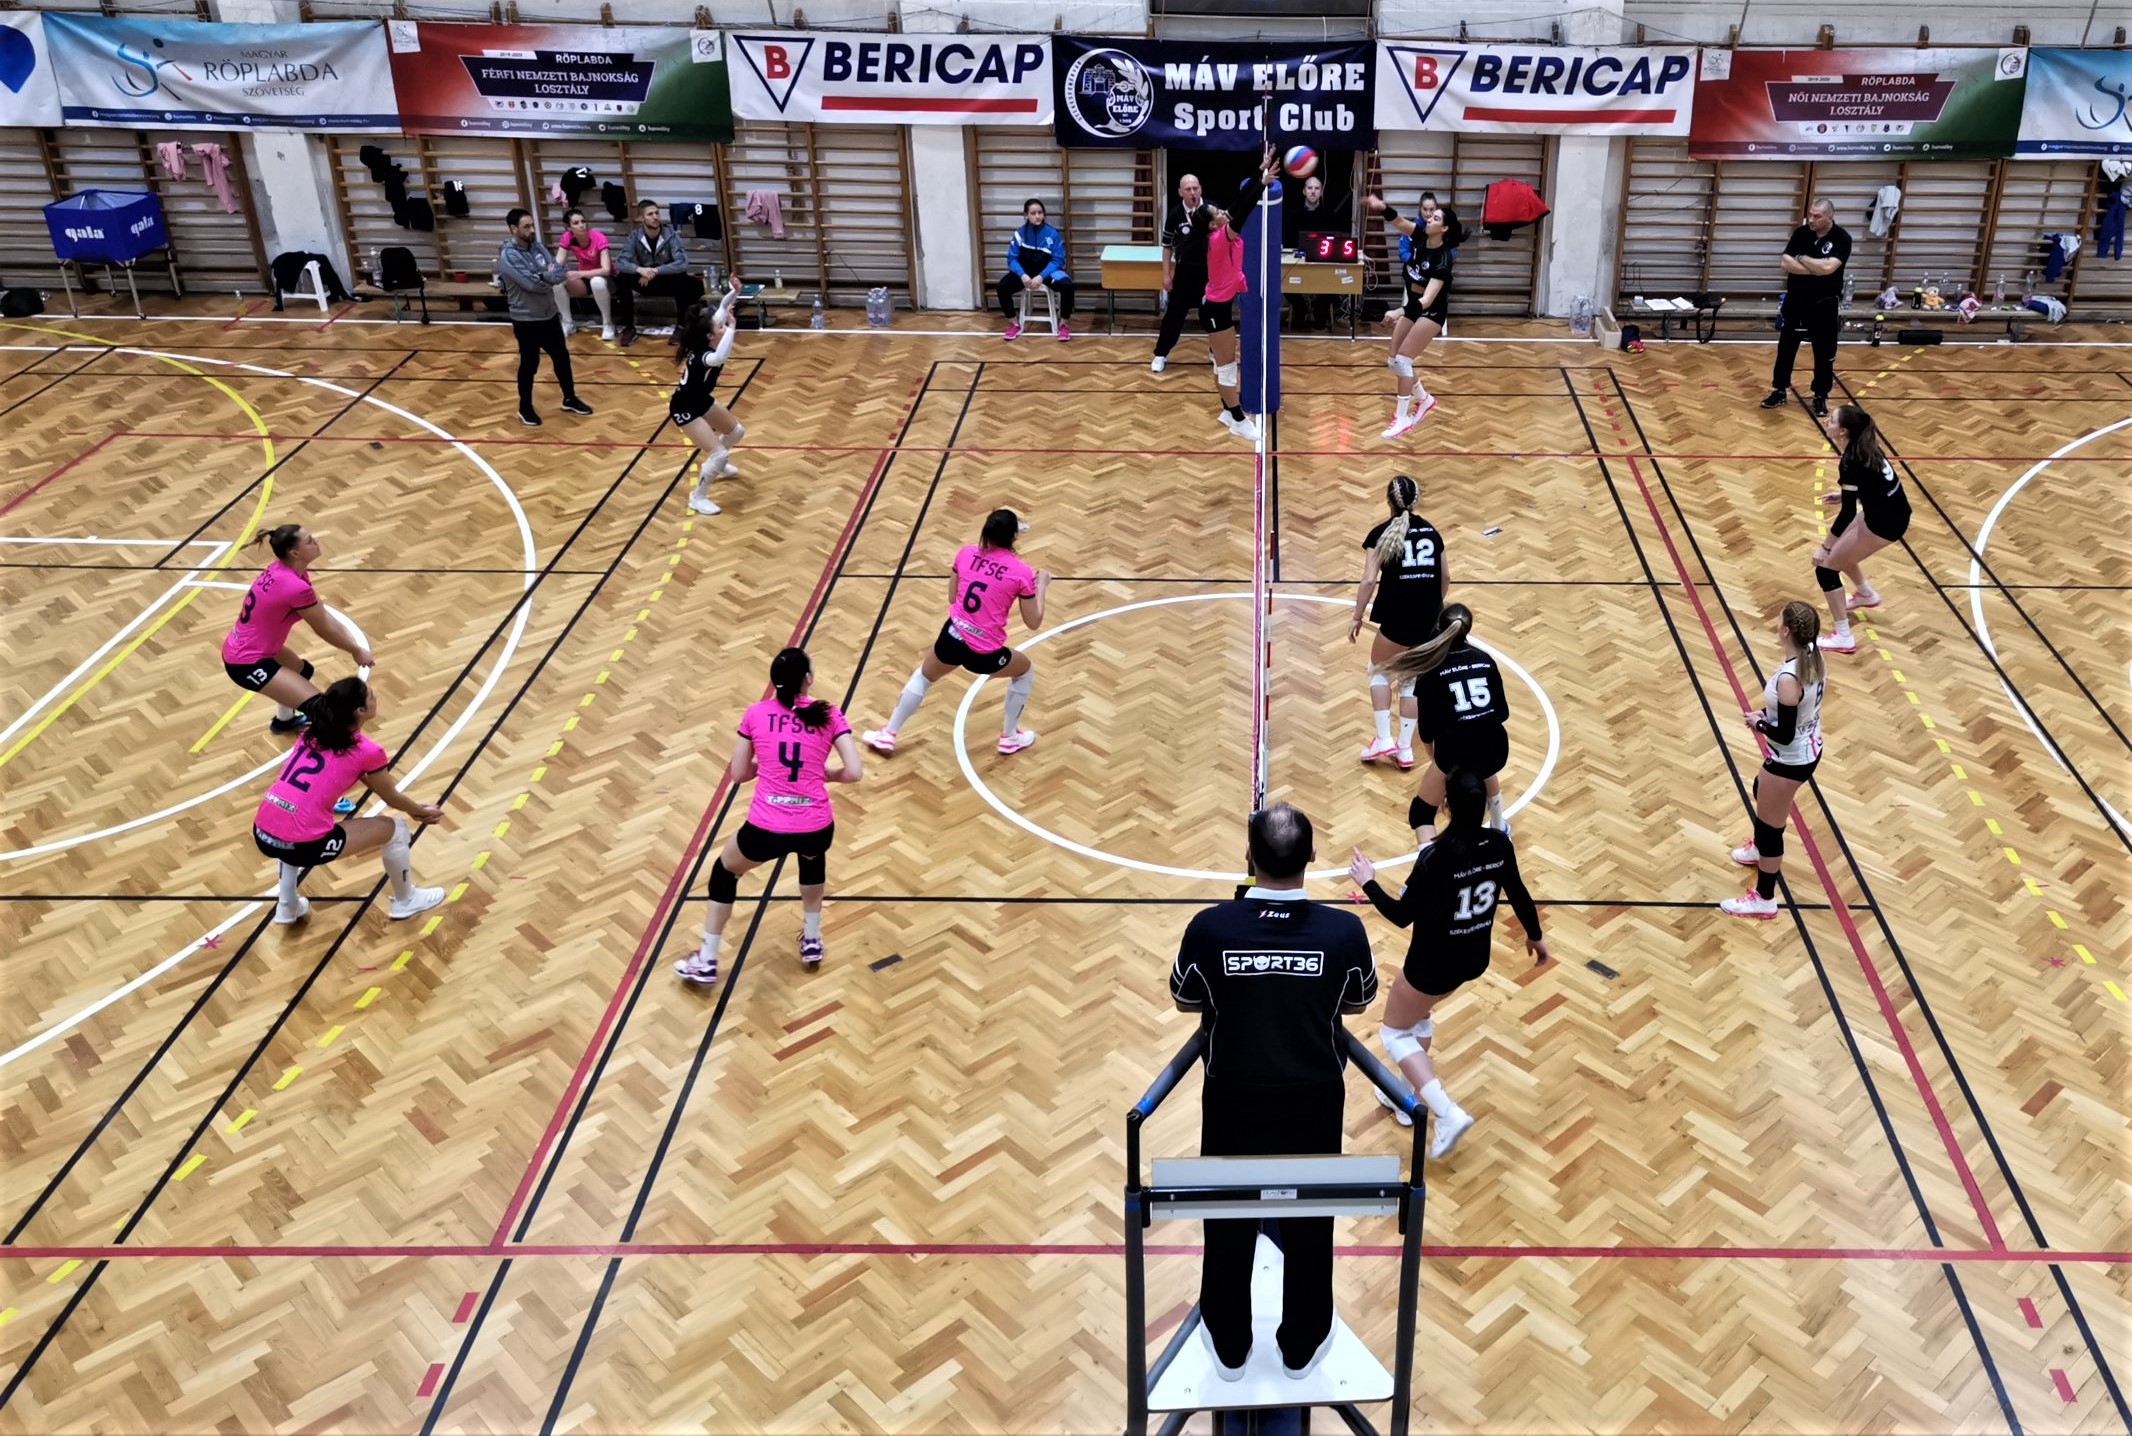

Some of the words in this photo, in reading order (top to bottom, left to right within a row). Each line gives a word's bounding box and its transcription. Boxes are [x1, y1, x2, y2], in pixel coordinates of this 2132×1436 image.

[241, 50, 288, 58] MAGYAR
[555, 54, 612, 65] RÖPLABDA
[765, 45, 791, 79] B
[823, 42, 1045, 83] BERICAP
[204, 59, 338, 82] RÖPLABDA
[481, 68, 515, 79] FÉRFI
[516, 71, 568, 81] NEMZETI
[569, 71, 639, 83] BAJNOKSÁG
[1164, 55, 1238, 91] MÁV
[1252, 55, 1365, 91] ELŐRE
[1415, 56, 1438, 90] B
[1470, 54, 1690, 95] BERICAP
[1861, 76, 1916, 86] RÖPLABDA
[242, 86, 304, 97] SZÖVETSÉG
[1116, 94, 1135, 102] MÁV
[1788, 93, 1809, 103] NŐI
[1810, 93, 1862, 103] NEMZETI
[1863, 91, 1930, 103] BAJNOKSÁG
[1112, 104, 1139, 113] ELŐRE
[1174, 102, 1263, 137] Sport
[1279, 103, 1355, 131] Club
[65, 226, 104, 242] gala
[130, 216, 155, 237] gala
[1320, 240, 1330, 255] 3
[1343, 240, 1353, 255] 5
[674, 412, 691, 424] 20
[1402, 538, 1435, 568] 12
[970, 555, 1008, 581] TFSE
[963, 581, 988, 614] 6
[246, 668, 268, 685] 13
[1448, 677, 1491, 713] 15
[280, 745, 326, 793] 12
[779, 742, 804, 782] 4
[1453, 870, 1467, 879] MÁV
[1453, 880, 1497, 921] 13
[1266, 911, 1291, 919] Zeus
[1227, 955, 1319, 972] SPORT36
